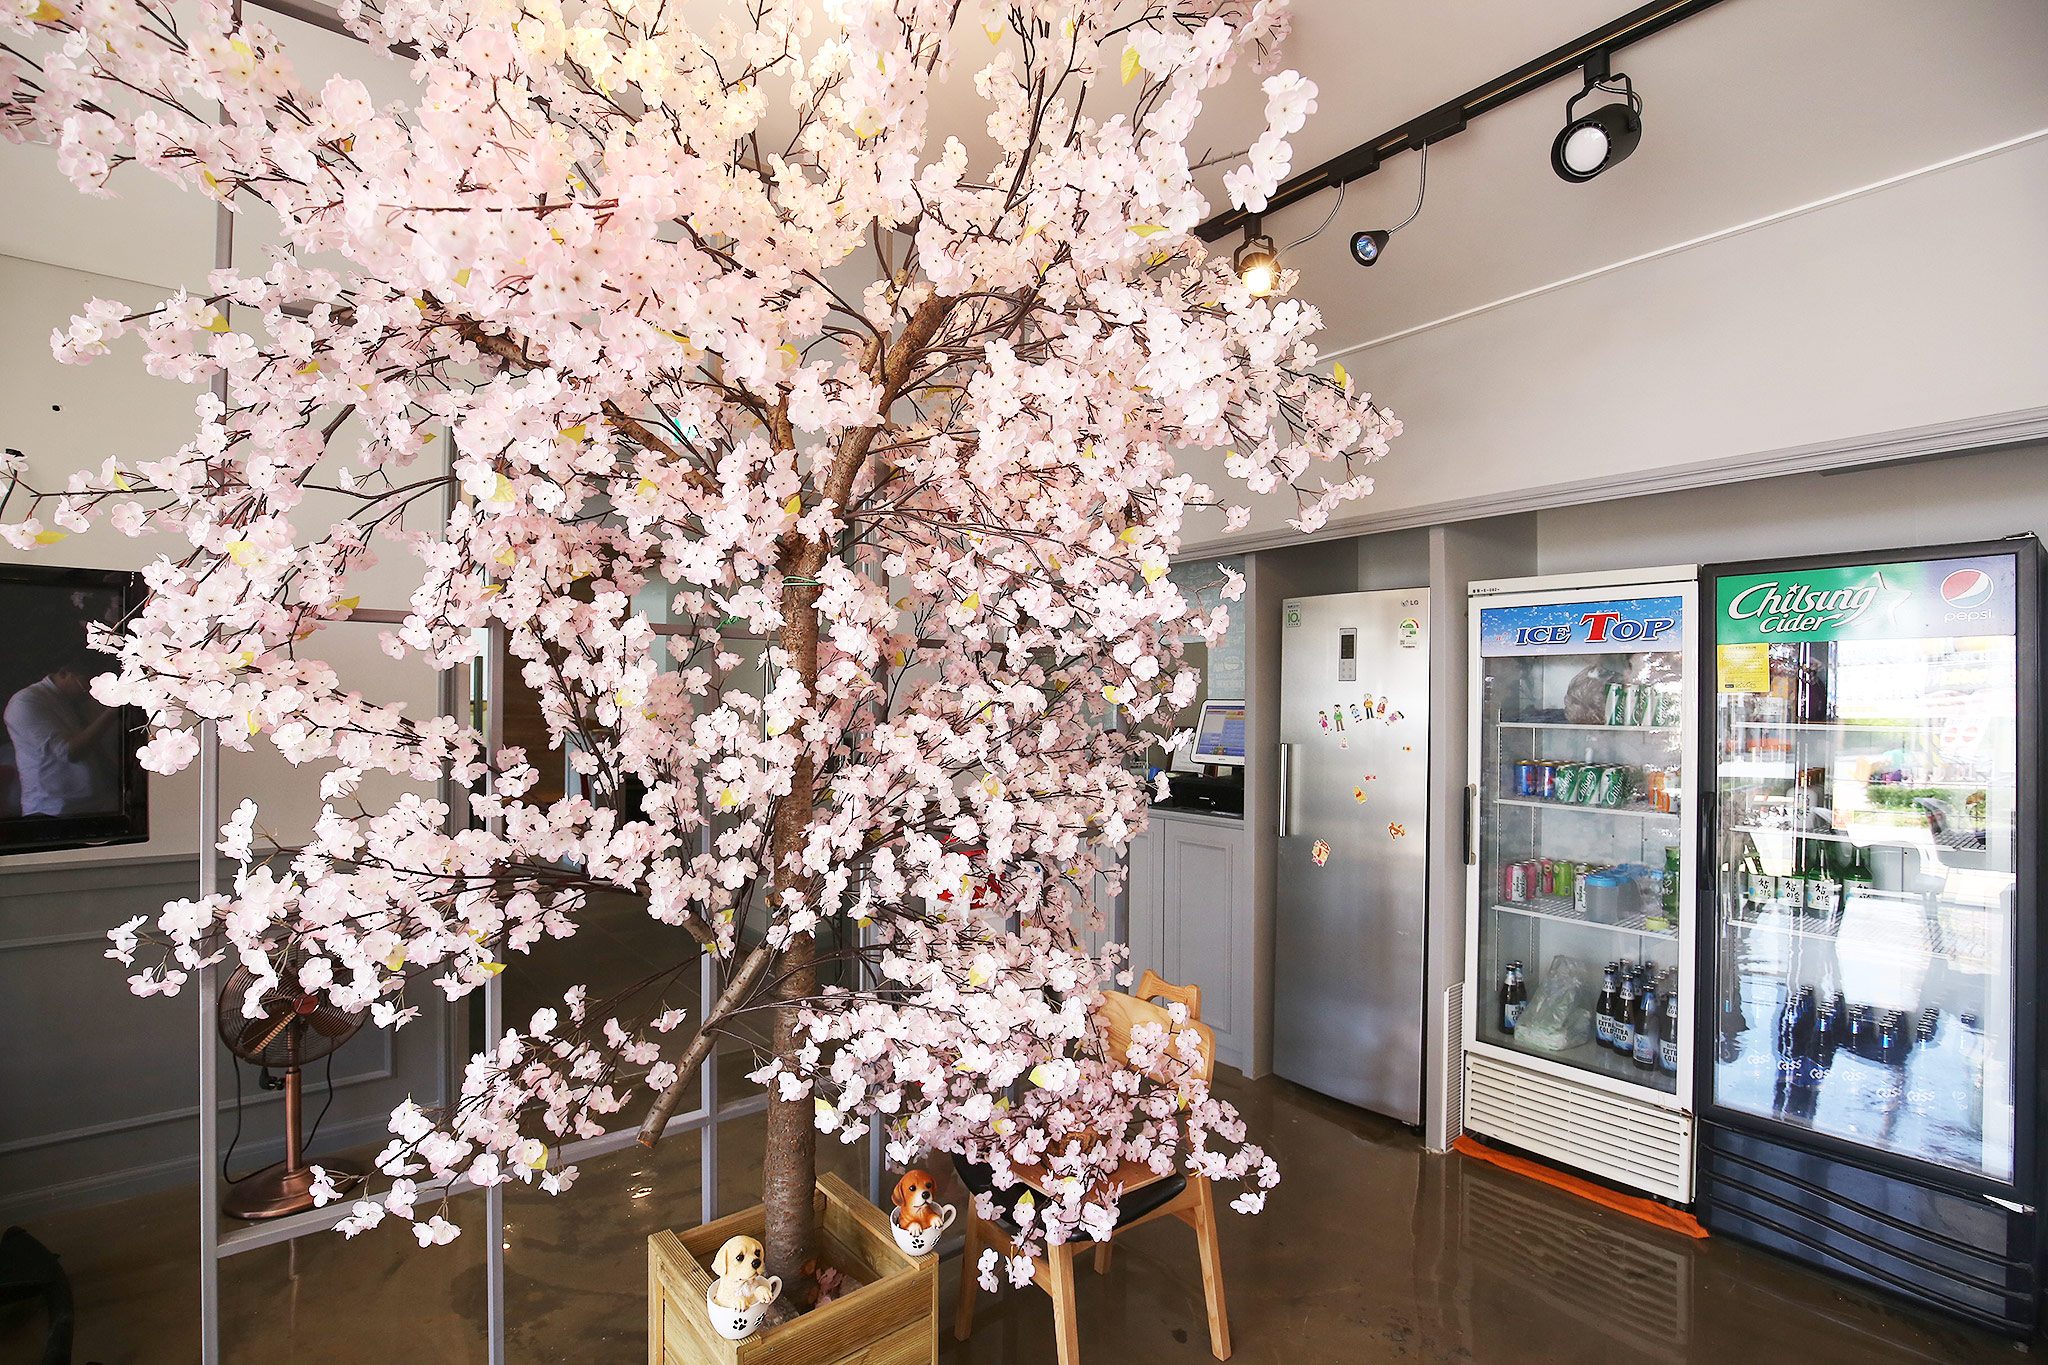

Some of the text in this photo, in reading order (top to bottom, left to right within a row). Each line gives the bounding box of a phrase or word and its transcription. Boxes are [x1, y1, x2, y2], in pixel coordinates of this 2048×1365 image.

[1727, 579, 1881, 628] Chilsung
[1943, 608, 1993, 624] pepsi
[1514, 624, 1572, 646] ICE
[1579, 610, 1675, 644] TOP
